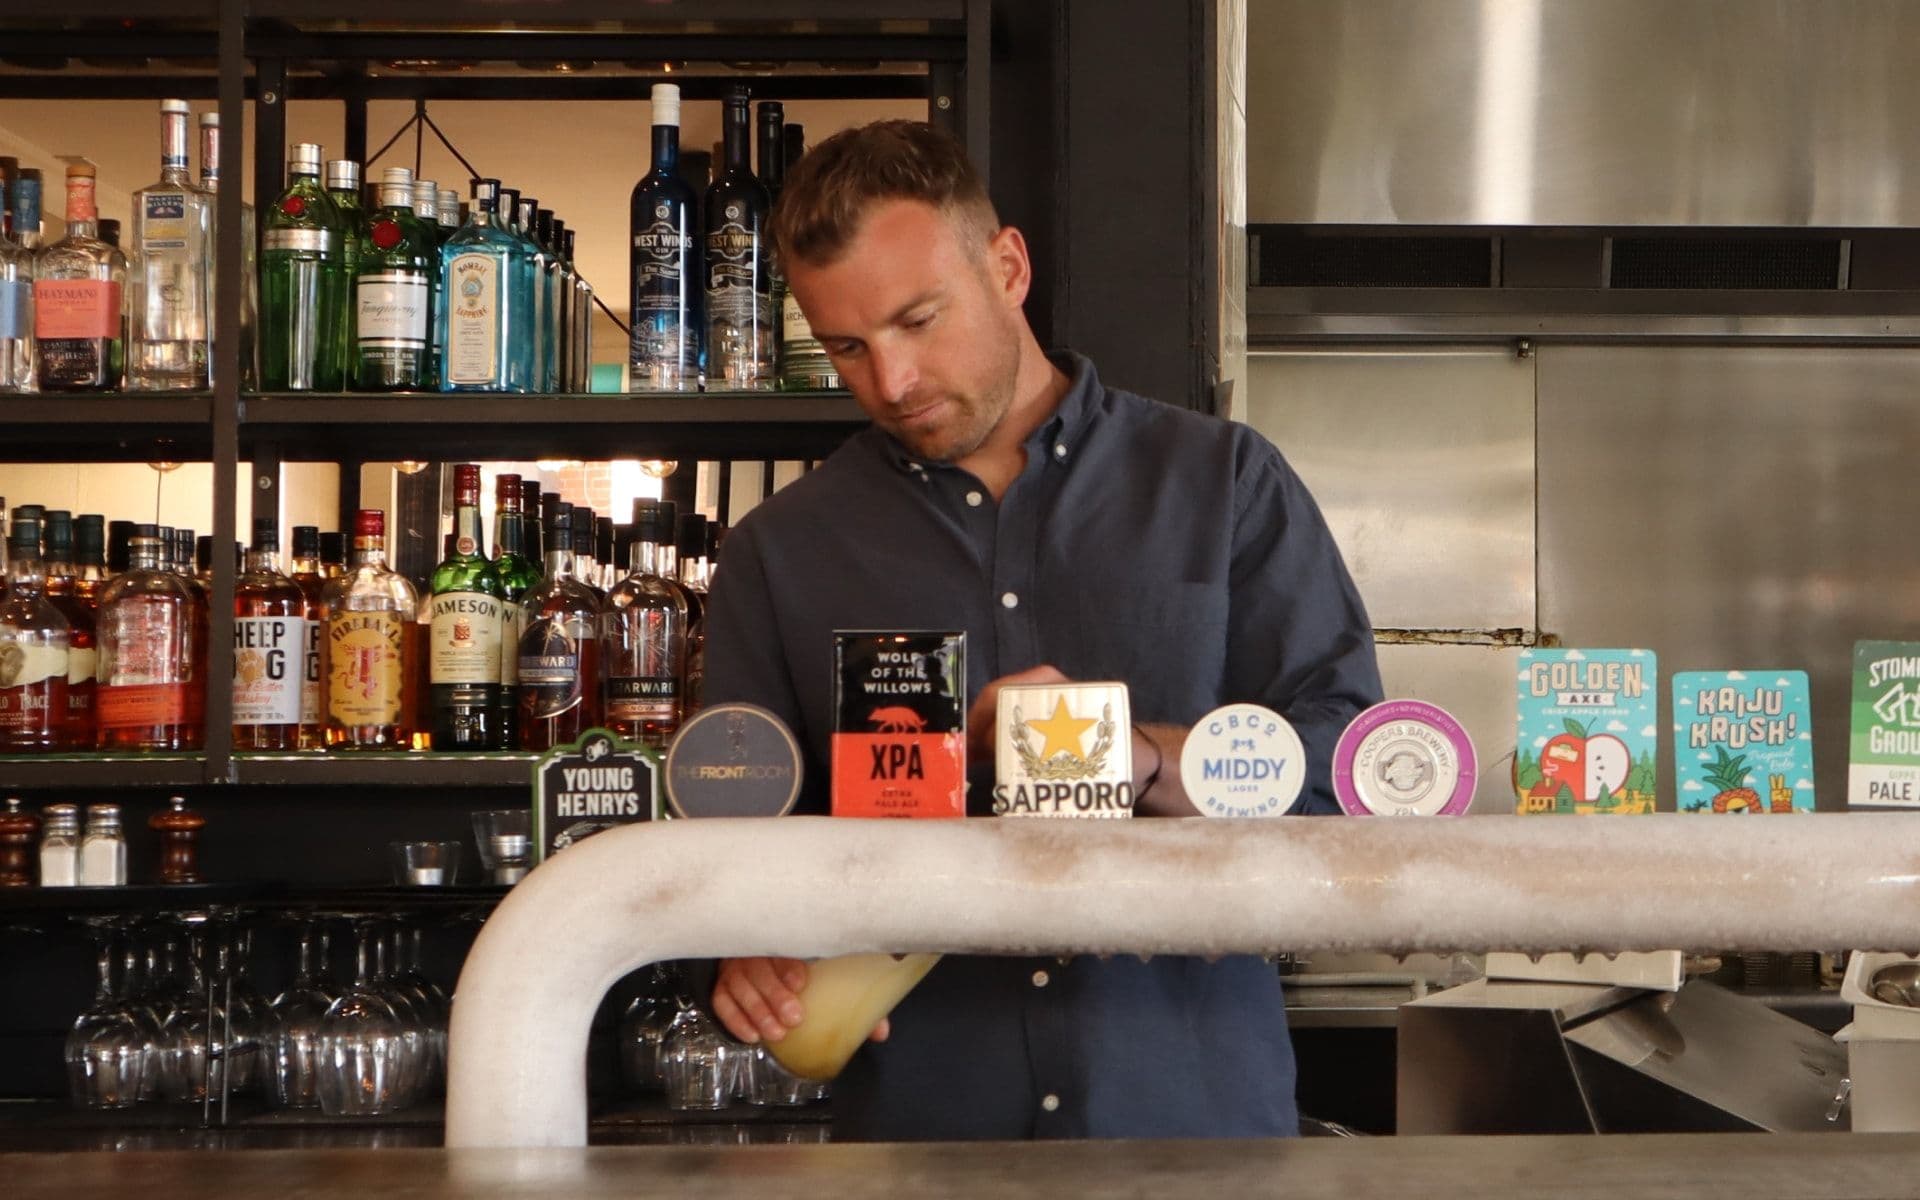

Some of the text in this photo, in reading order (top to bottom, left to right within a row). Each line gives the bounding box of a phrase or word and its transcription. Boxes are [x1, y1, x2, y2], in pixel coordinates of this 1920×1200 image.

[634, 234, 658, 247] WEST
[458, 261, 488, 273] BOMBAY
[432, 599, 498, 619] JAMESON
[877, 652, 918, 664] WOLF
[871, 667, 927, 679] OF THE
[1530, 661, 1643, 698] GOLDEN
[863, 682, 932, 694] WILLOWS
[1569, 694, 1603, 704] AXE
[1697, 687, 1783, 718] KAIJU
[1690, 712, 1797, 749] KRUSH!
[1361, 725, 1450, 768] COOPERS BREWERY
[870, 744, 924, 780] XPA
[1202, 758, 1287, 780] MIDDY
[562, 767, 634, 792] YOUNG
[1227, 785, 1260, 793] LAGER
[991, 780, 1136, 815] SAPPORO
[1869, 781, 1913, 801] PALE
[556, 792, 639, 817] HENRYS
[1205, 796, 1279, 817] BREWING
